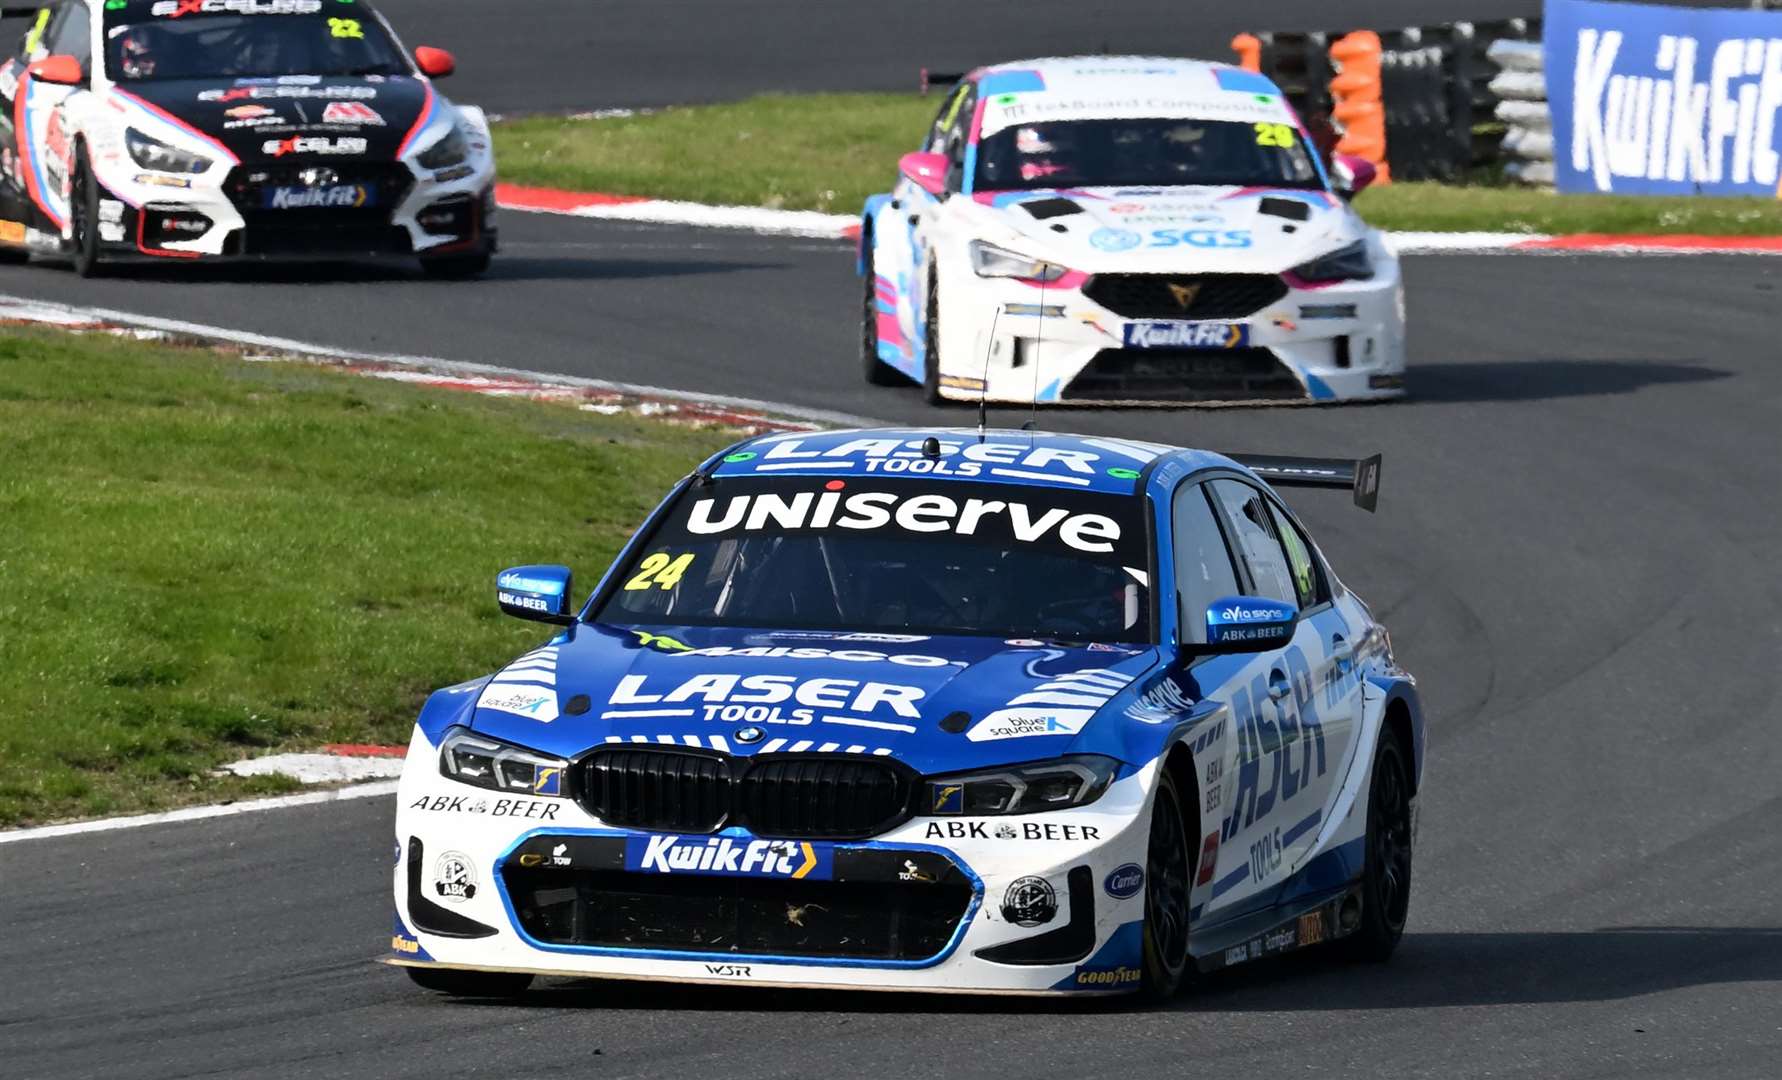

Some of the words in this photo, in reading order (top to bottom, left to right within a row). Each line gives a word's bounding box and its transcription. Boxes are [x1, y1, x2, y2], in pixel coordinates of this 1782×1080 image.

[327, 17, 364, 39] 22
[1255, 122, 1294, 147] 29
[272, 185, 356, 208] KwikFit
[1148, 229, 1253, 248] SGS
[1129, 323, 1229, 346] KwikFit
[764, 438, 1100, 473] LASER
[864, 456, 982, 475] TOOLS
[624, 553, 696, 591] 24
[523, 597, 548, 612] BEER
[1222, 630, 1246, 640] ABK
[1257, 626, 1284, 639] BEER
[608, 674, 926, 718] LASER
[702, 704, 815, 726] TOOLS
[1008, 716, 1047, 727] blue
[990, 726, 1046, 737] square
[410, 796, 469, 812] ABK
[492, 800, 561, 820] BEER
[925, 821, 990, 840] ABK
[1023, 823, 1101, 841] BEER
[553, 857, 572, 866] TOW
[641, 836, 801, 873] KwikFit
[444, 883, 467, 896] ABK
[1111, 873, 1141, 890] Carrier
[704, 965, 751, 977] WSR
[1078, 967, 1141, 986] GOODYEAR
